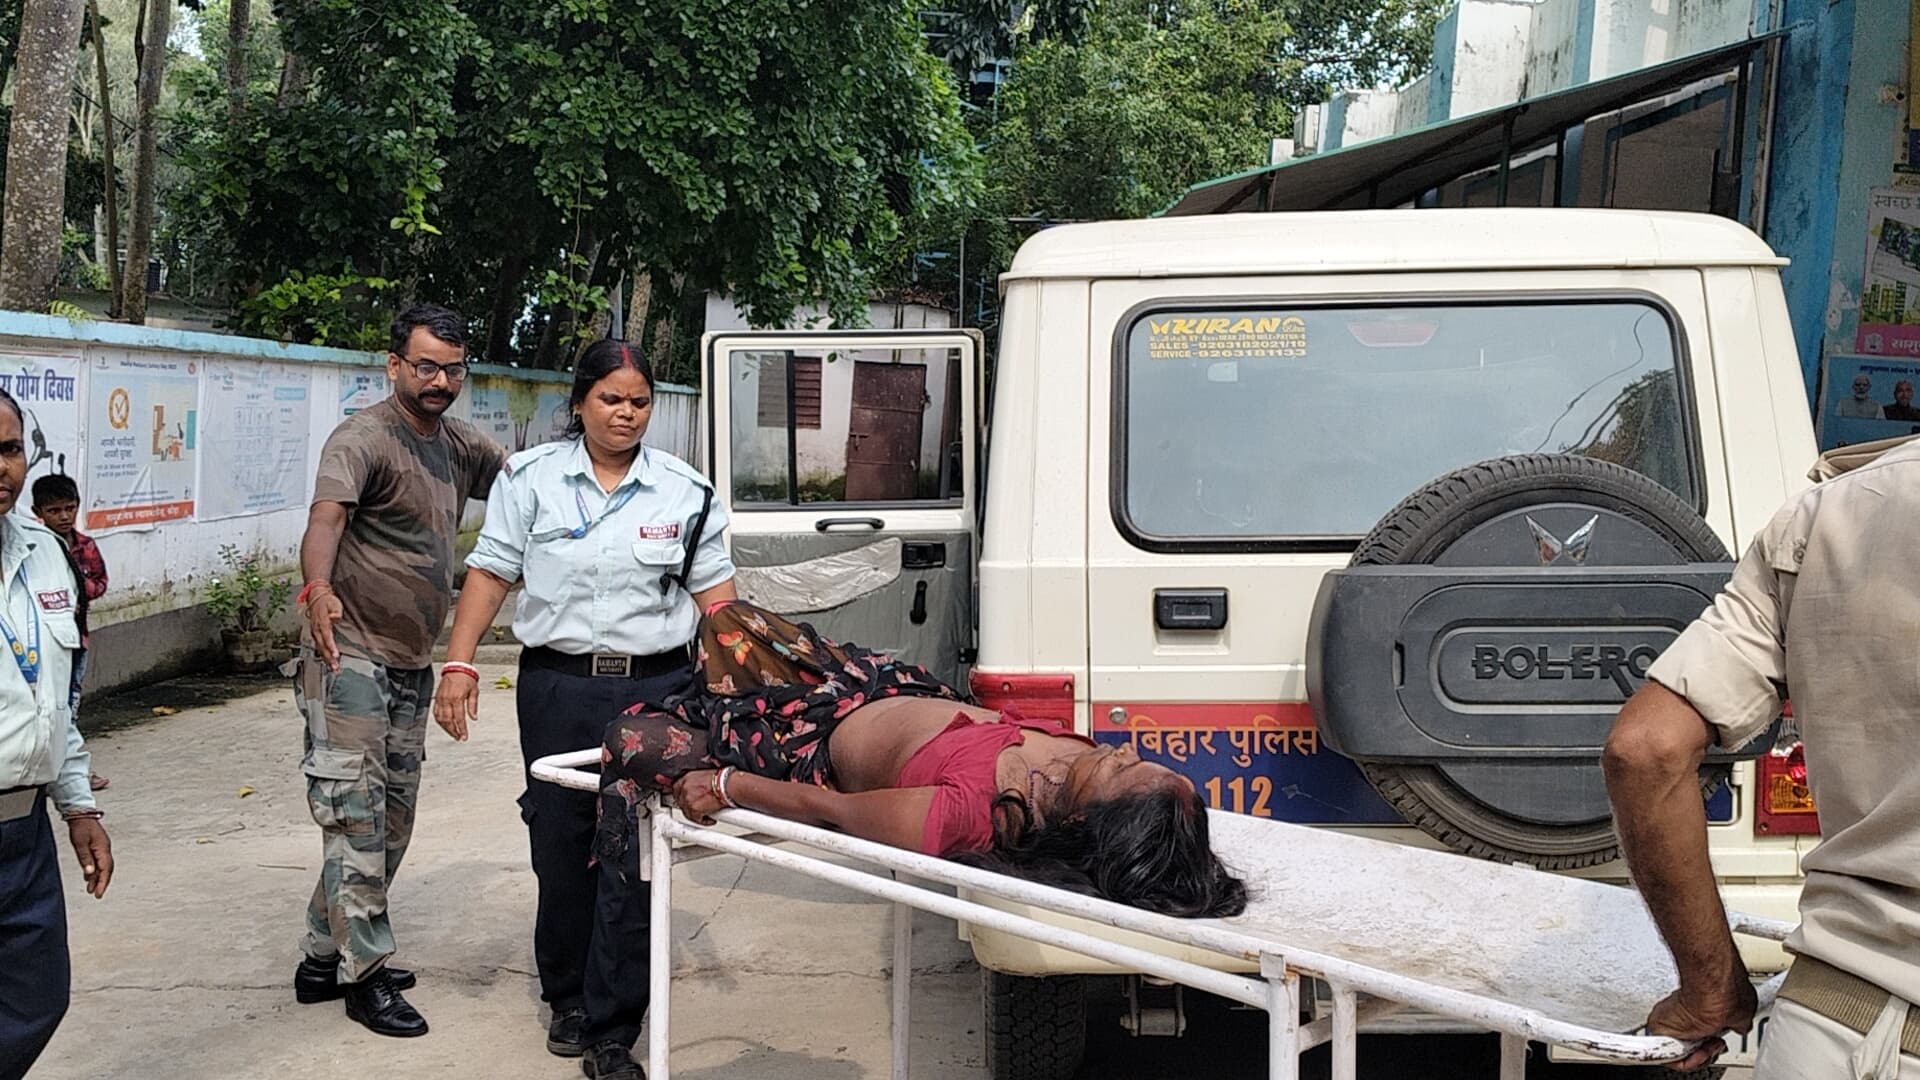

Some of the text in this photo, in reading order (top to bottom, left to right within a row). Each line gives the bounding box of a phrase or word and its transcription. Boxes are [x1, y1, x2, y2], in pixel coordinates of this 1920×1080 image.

[1172, 317, 1281, 334] KIRAN
[1150, 341, 1189, 349] SALES
[1150, 350, 1192, 358] SERVICE
[16, 367, 41, 401] योग
[44, 368, 75, 401] दिवस
[1472, 645, 1659, 697] BOLERO
[1128, 714, 1320, 768] बिहार पुलिस
[1205, 776, 1273, 817] 112
